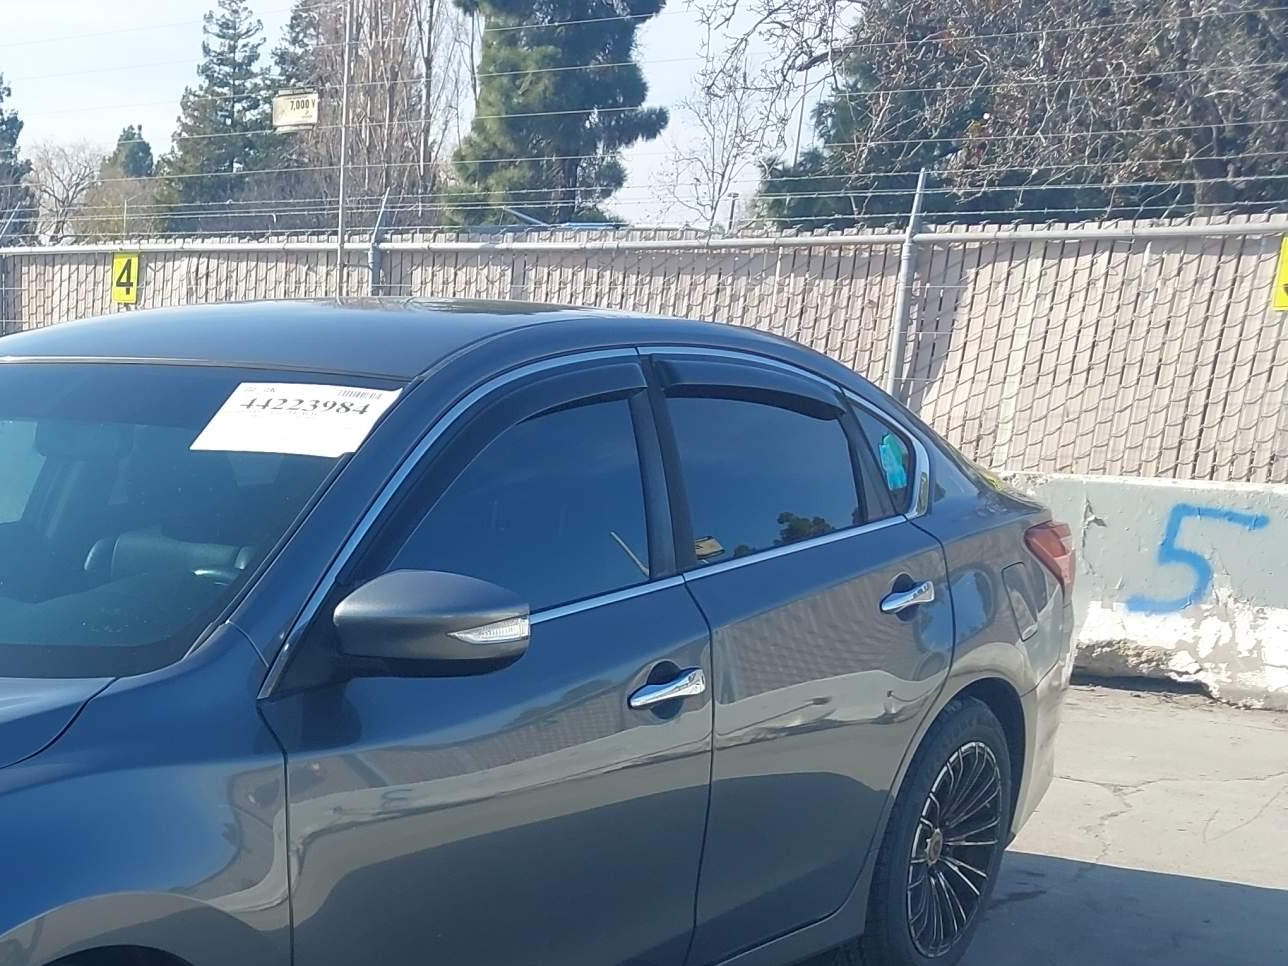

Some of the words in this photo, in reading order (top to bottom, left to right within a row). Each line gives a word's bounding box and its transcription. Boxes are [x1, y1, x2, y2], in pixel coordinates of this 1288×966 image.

[290, 99, 310, 112] 7,000
[116, 258, 134, 295] 4
[240, 397, 371, 415] 44223984
[1125, 503, 1270, 614] 5
